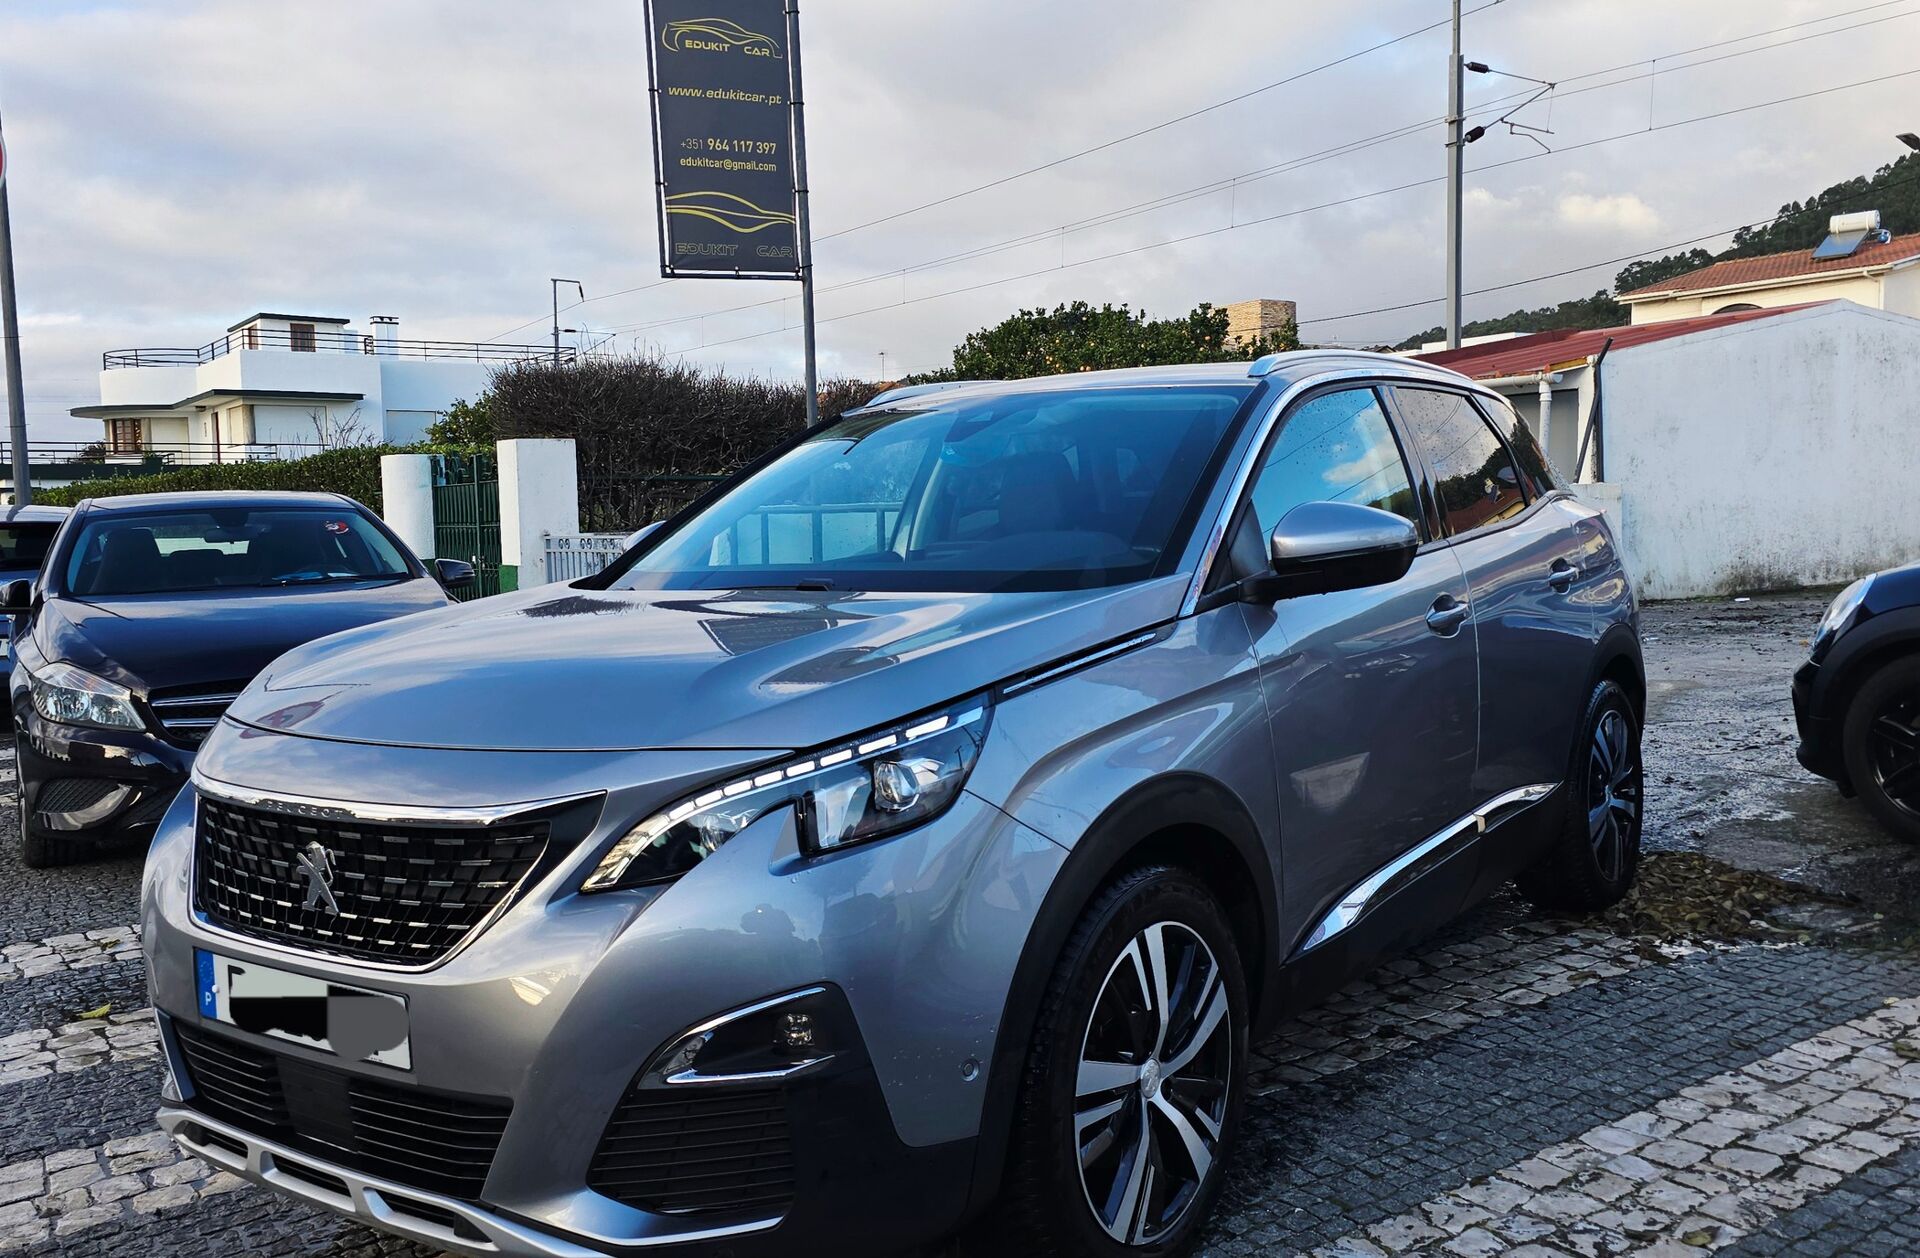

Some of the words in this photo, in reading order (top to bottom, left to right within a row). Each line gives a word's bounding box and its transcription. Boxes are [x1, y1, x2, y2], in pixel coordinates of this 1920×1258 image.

[685, 39, 730, 52] EDUKIT
[744, 46, 770, 57] CAR
[668, 87, 782, 105] www.edukitcar.pt
[680, 138, 703, 150] +351
[707, 138, 729, 151] 964
[733, 140, 753, 153] 117
[756, 141, 776, 154] 397
[680, 157, 776, 172] edukitcar@gmail.com
[675, 243, 738, 256] EDUKIT
[756, 245, 793, 258] CAR
[267, 801, 343, 819] PEUGEOT
[205, 991, 212, 1005] P
